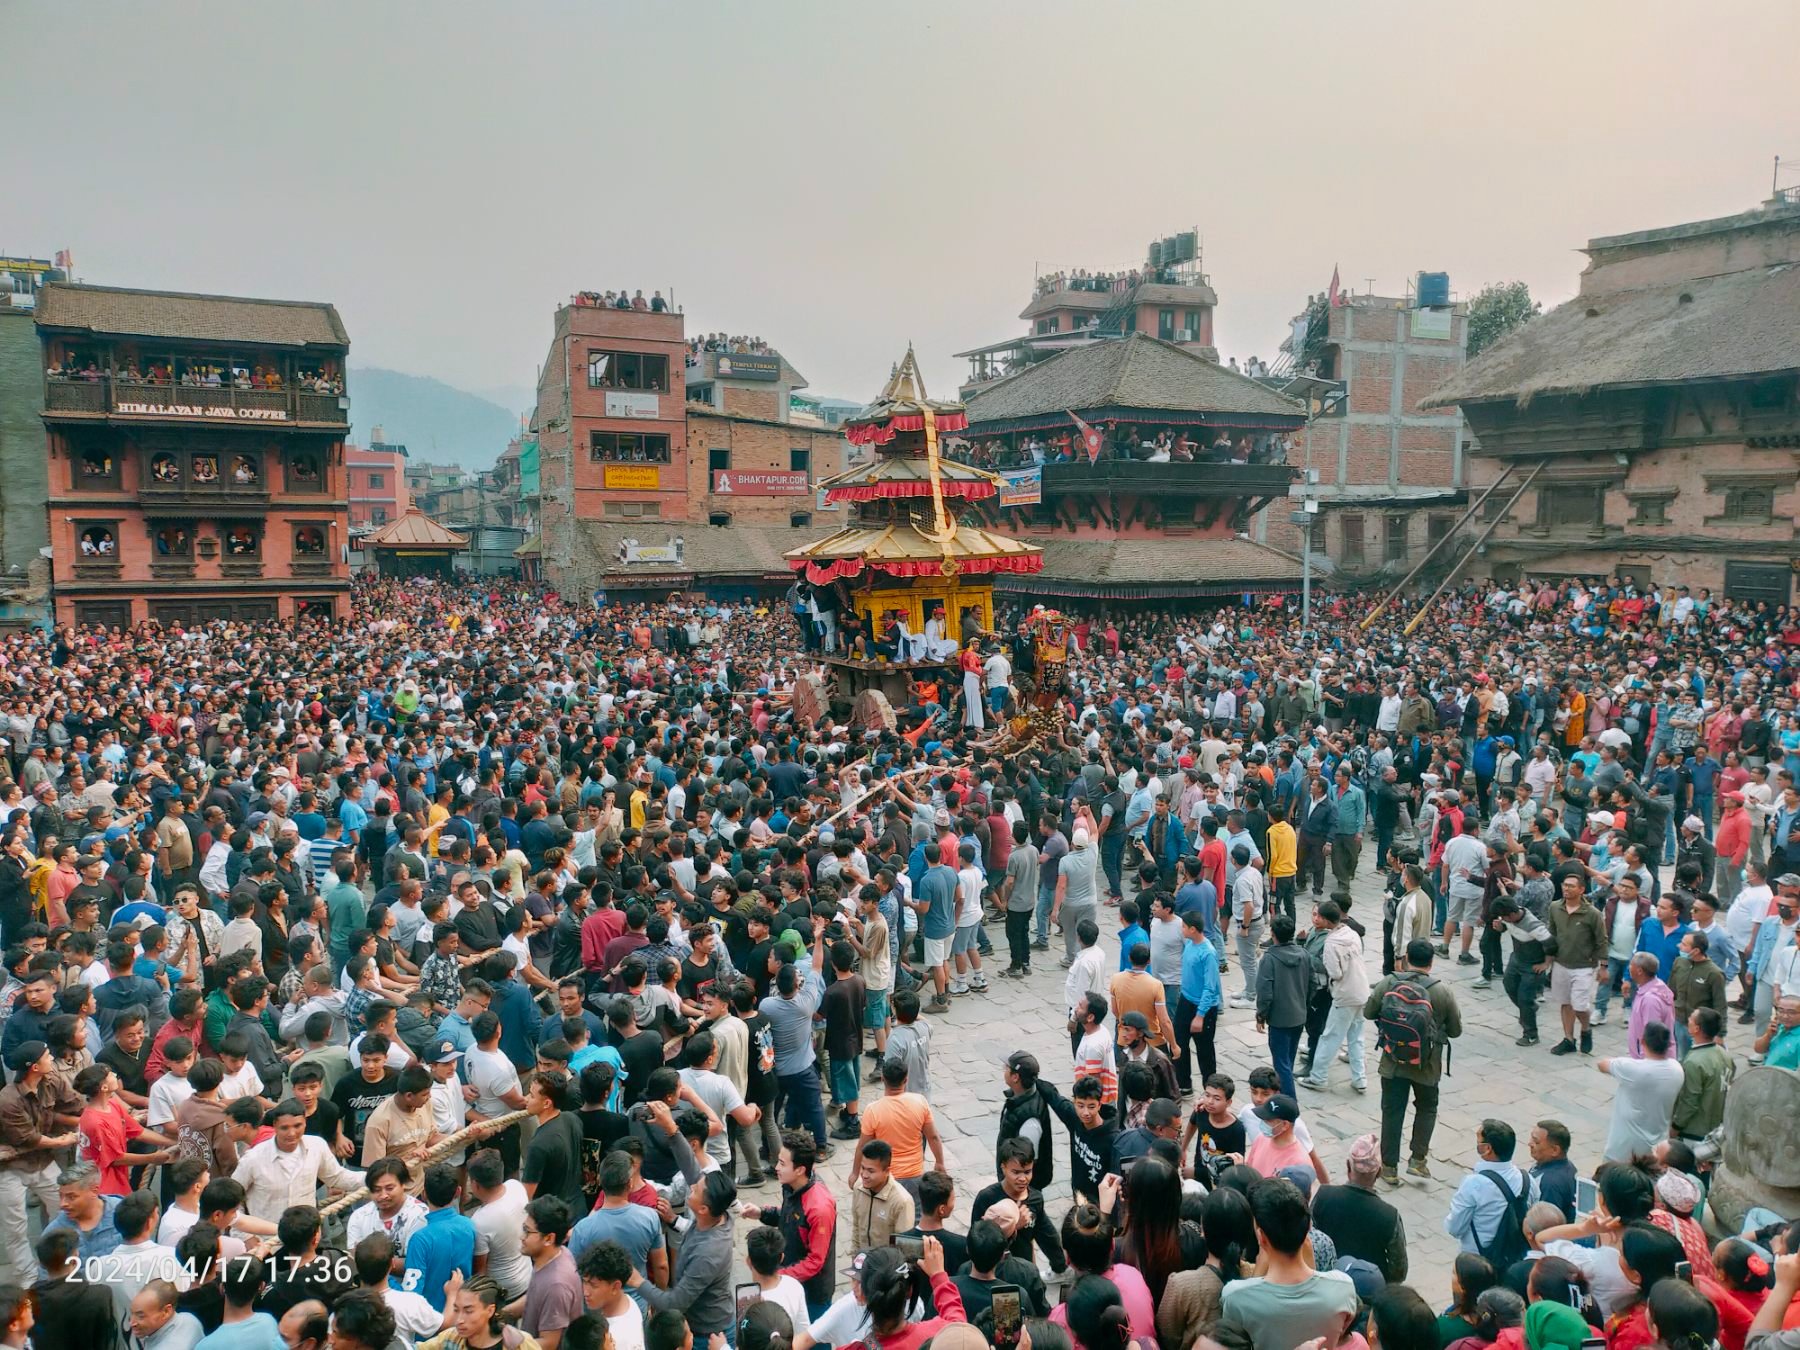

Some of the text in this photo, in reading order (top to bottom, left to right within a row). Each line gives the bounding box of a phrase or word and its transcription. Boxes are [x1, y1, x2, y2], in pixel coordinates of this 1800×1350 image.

[118, 402, 287, 420] HIMALAYAN JAVA COFFEE
[738, 474, 806, 485] BHAKTAPUR.COM
